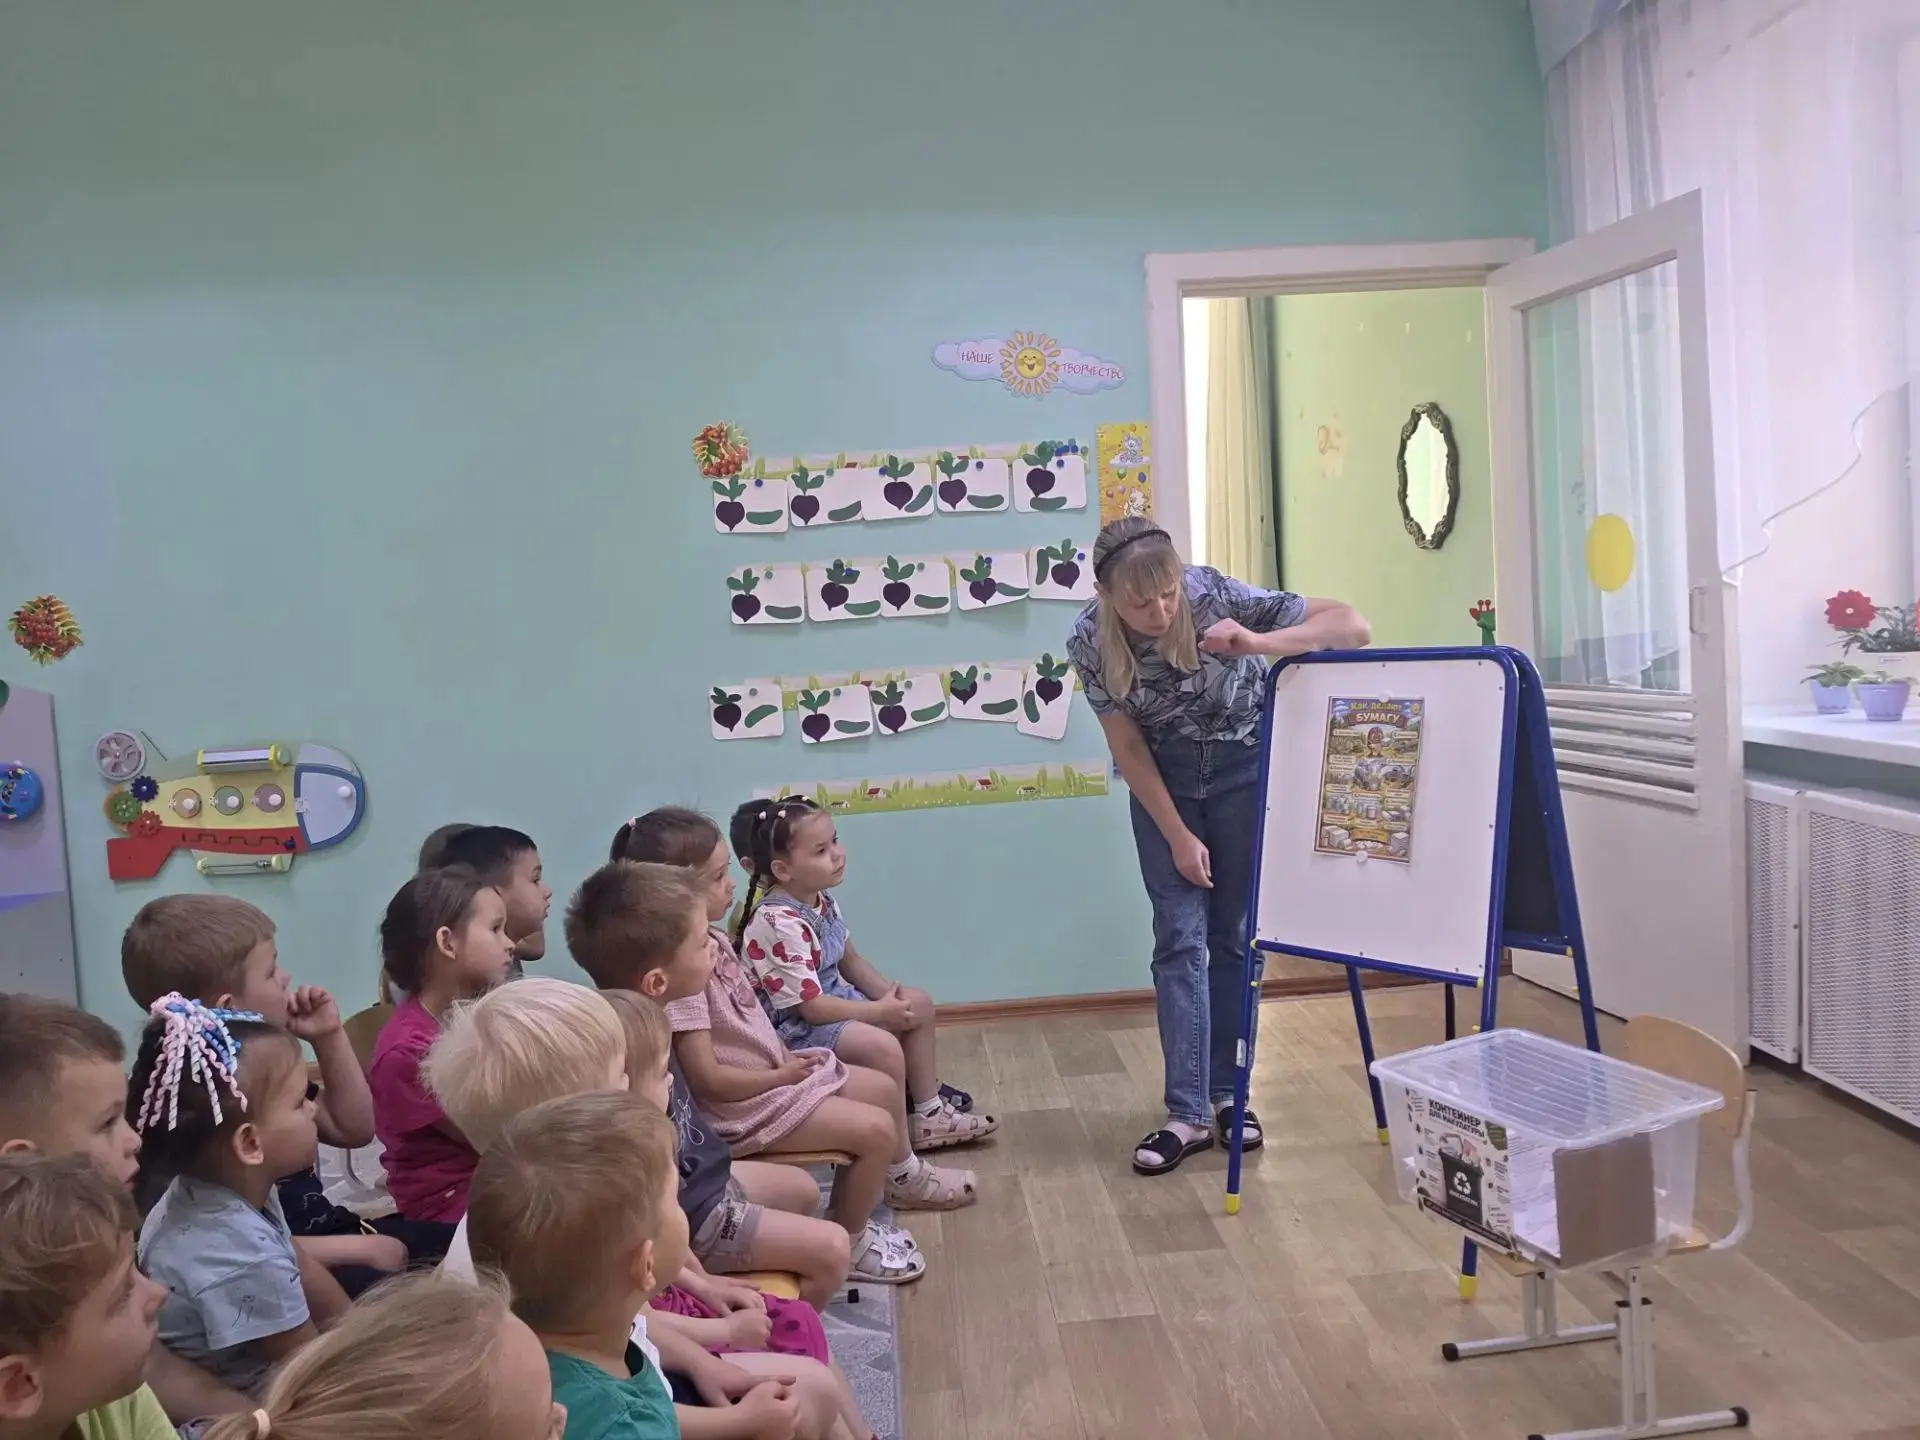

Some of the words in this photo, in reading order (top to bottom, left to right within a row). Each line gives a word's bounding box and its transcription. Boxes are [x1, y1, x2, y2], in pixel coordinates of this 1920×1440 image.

[961, 350, 994, 364] НАШЕ
[1061, 362, 1124, 380] ТВОРЧЕСТВО
[1355, 712, 1400, 723] БУМАГУ
[1428, 1098, 1481, 1127] КОНТЕЙНЕР
